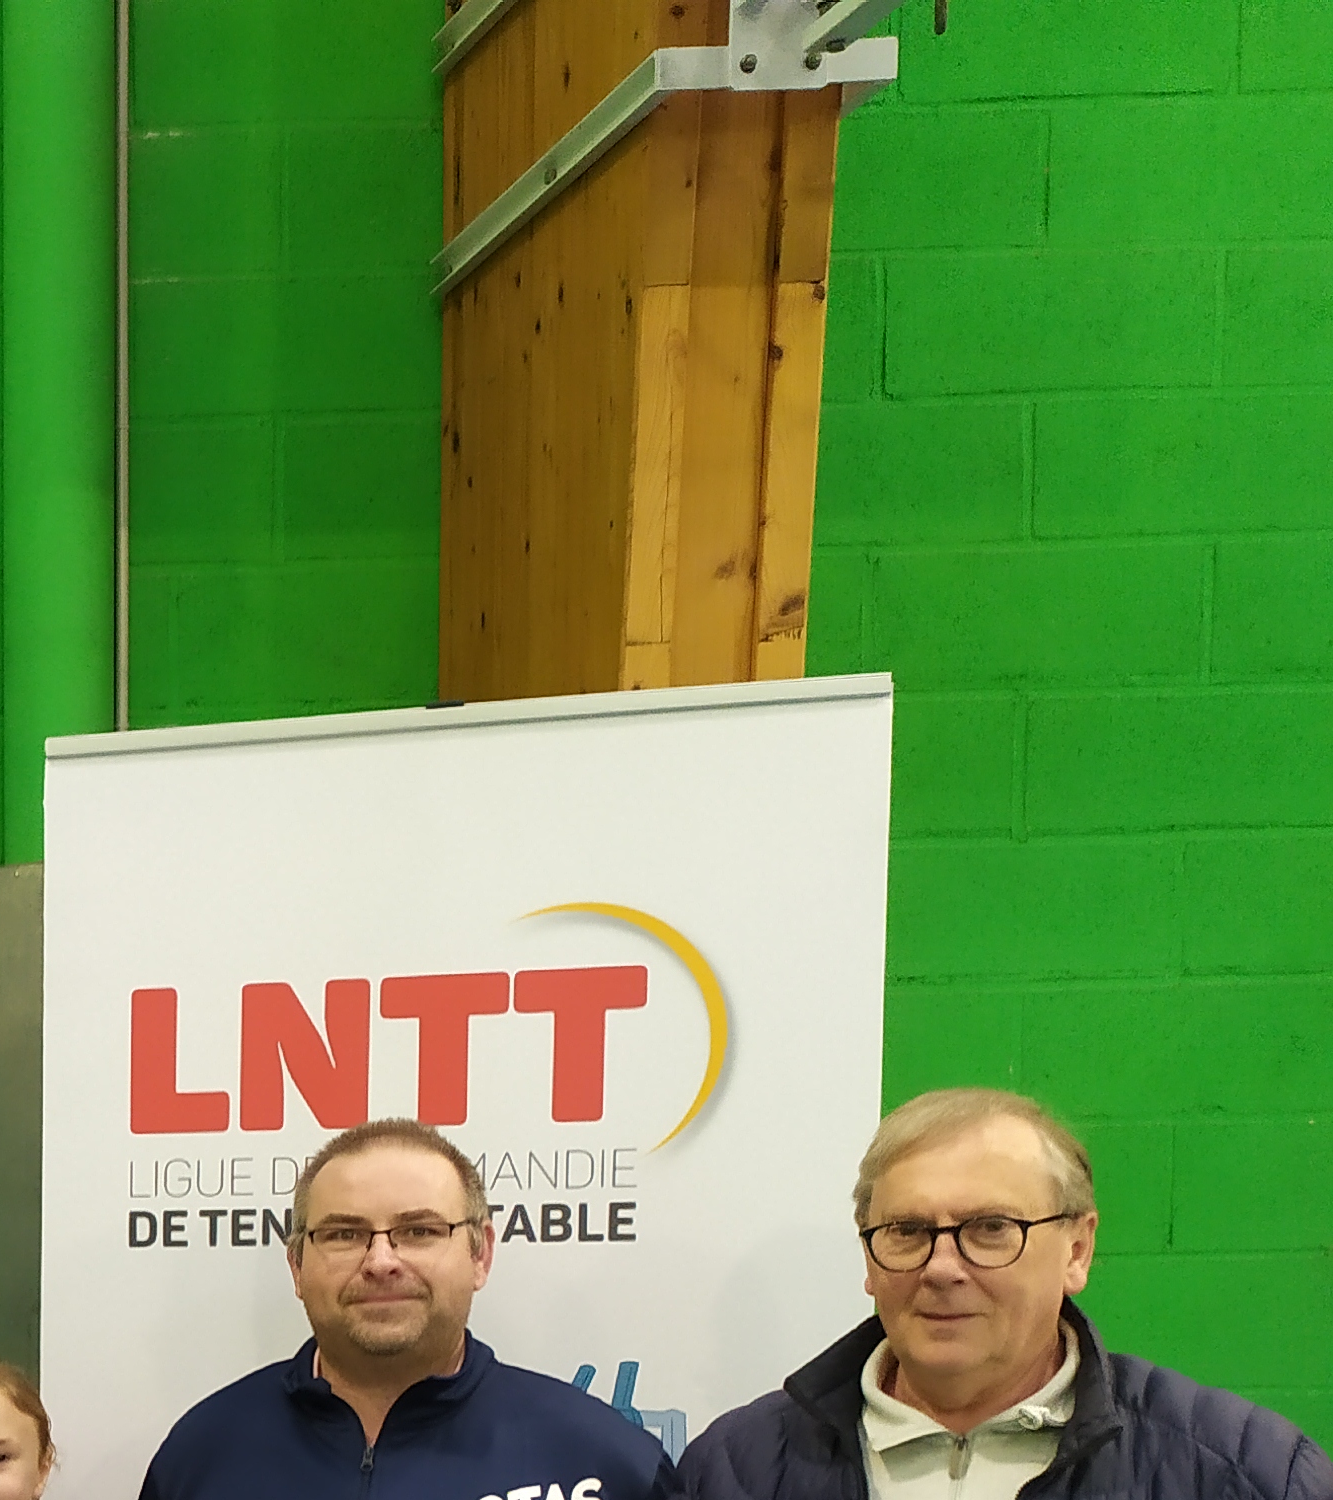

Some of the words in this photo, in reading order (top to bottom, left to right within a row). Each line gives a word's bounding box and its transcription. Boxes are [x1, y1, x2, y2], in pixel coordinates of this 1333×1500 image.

[130, 965, 648, 1134] LNTT
[129, 1157, 254, 1198] LIGUE
[272, 1156, 317, 1195] D
[474, 1148, 637, 1191] ANDIE
[128, 1210, 189, 1248] DE
[199, 1208, 293, 1247] TEN
